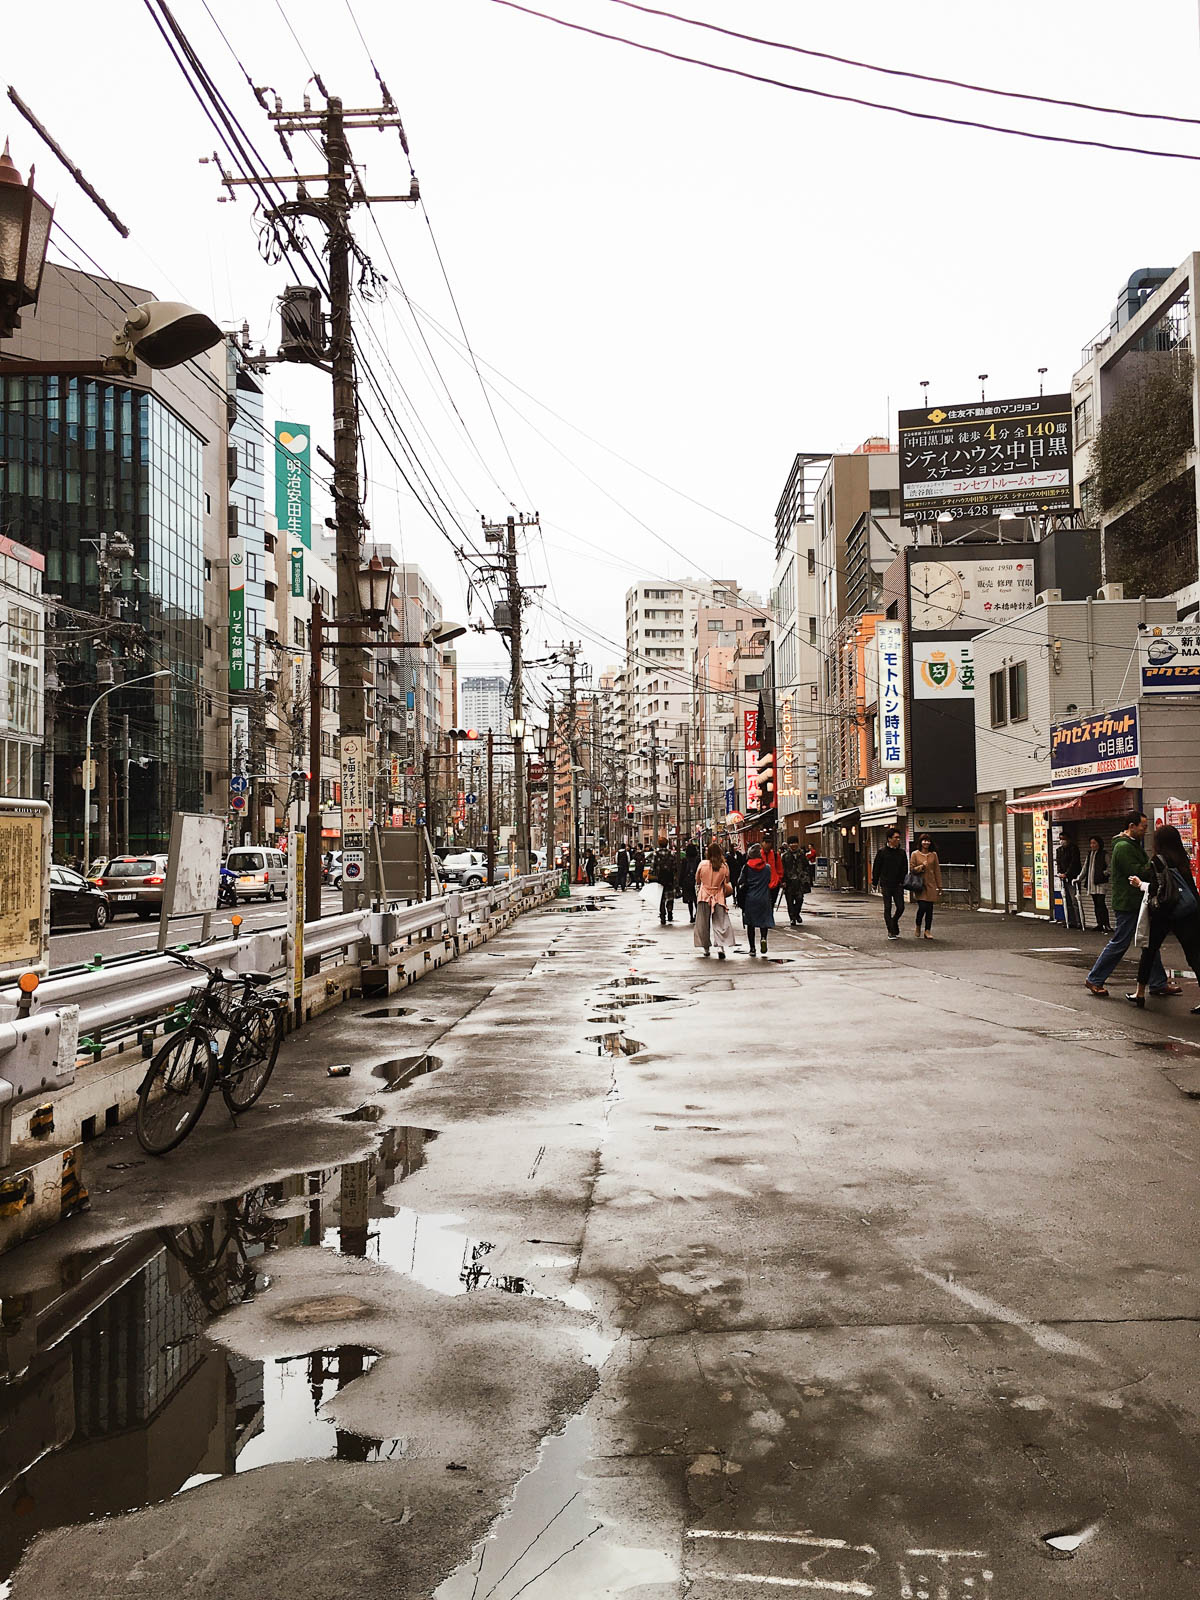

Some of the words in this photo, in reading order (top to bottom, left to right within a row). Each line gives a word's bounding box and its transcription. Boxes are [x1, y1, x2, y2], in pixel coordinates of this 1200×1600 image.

[947, 402, 1040, 420] 住友不動産のマンション
[904, 436, 1068, 469] シティハウス中目黒
[926, 457, 1041, 480] ステーションコート
[953, 472, 1067, 492] コンセプトルームオープン
[231, 610, 244, 671] りそな銀行
[884, 652, 901, 762] モトハシ時計店
[783, 704, 793, 784] PROVENCE
[1052, 714, 1135, 748] アクセスチケット
[1098, 735, 1134, 758] 中目黒店
[1096, 761, 1117, 773] ACCESS
[1117, 756, 1136, 769] TICKET
[347, 756, 356, 807] 七田チャイルド
